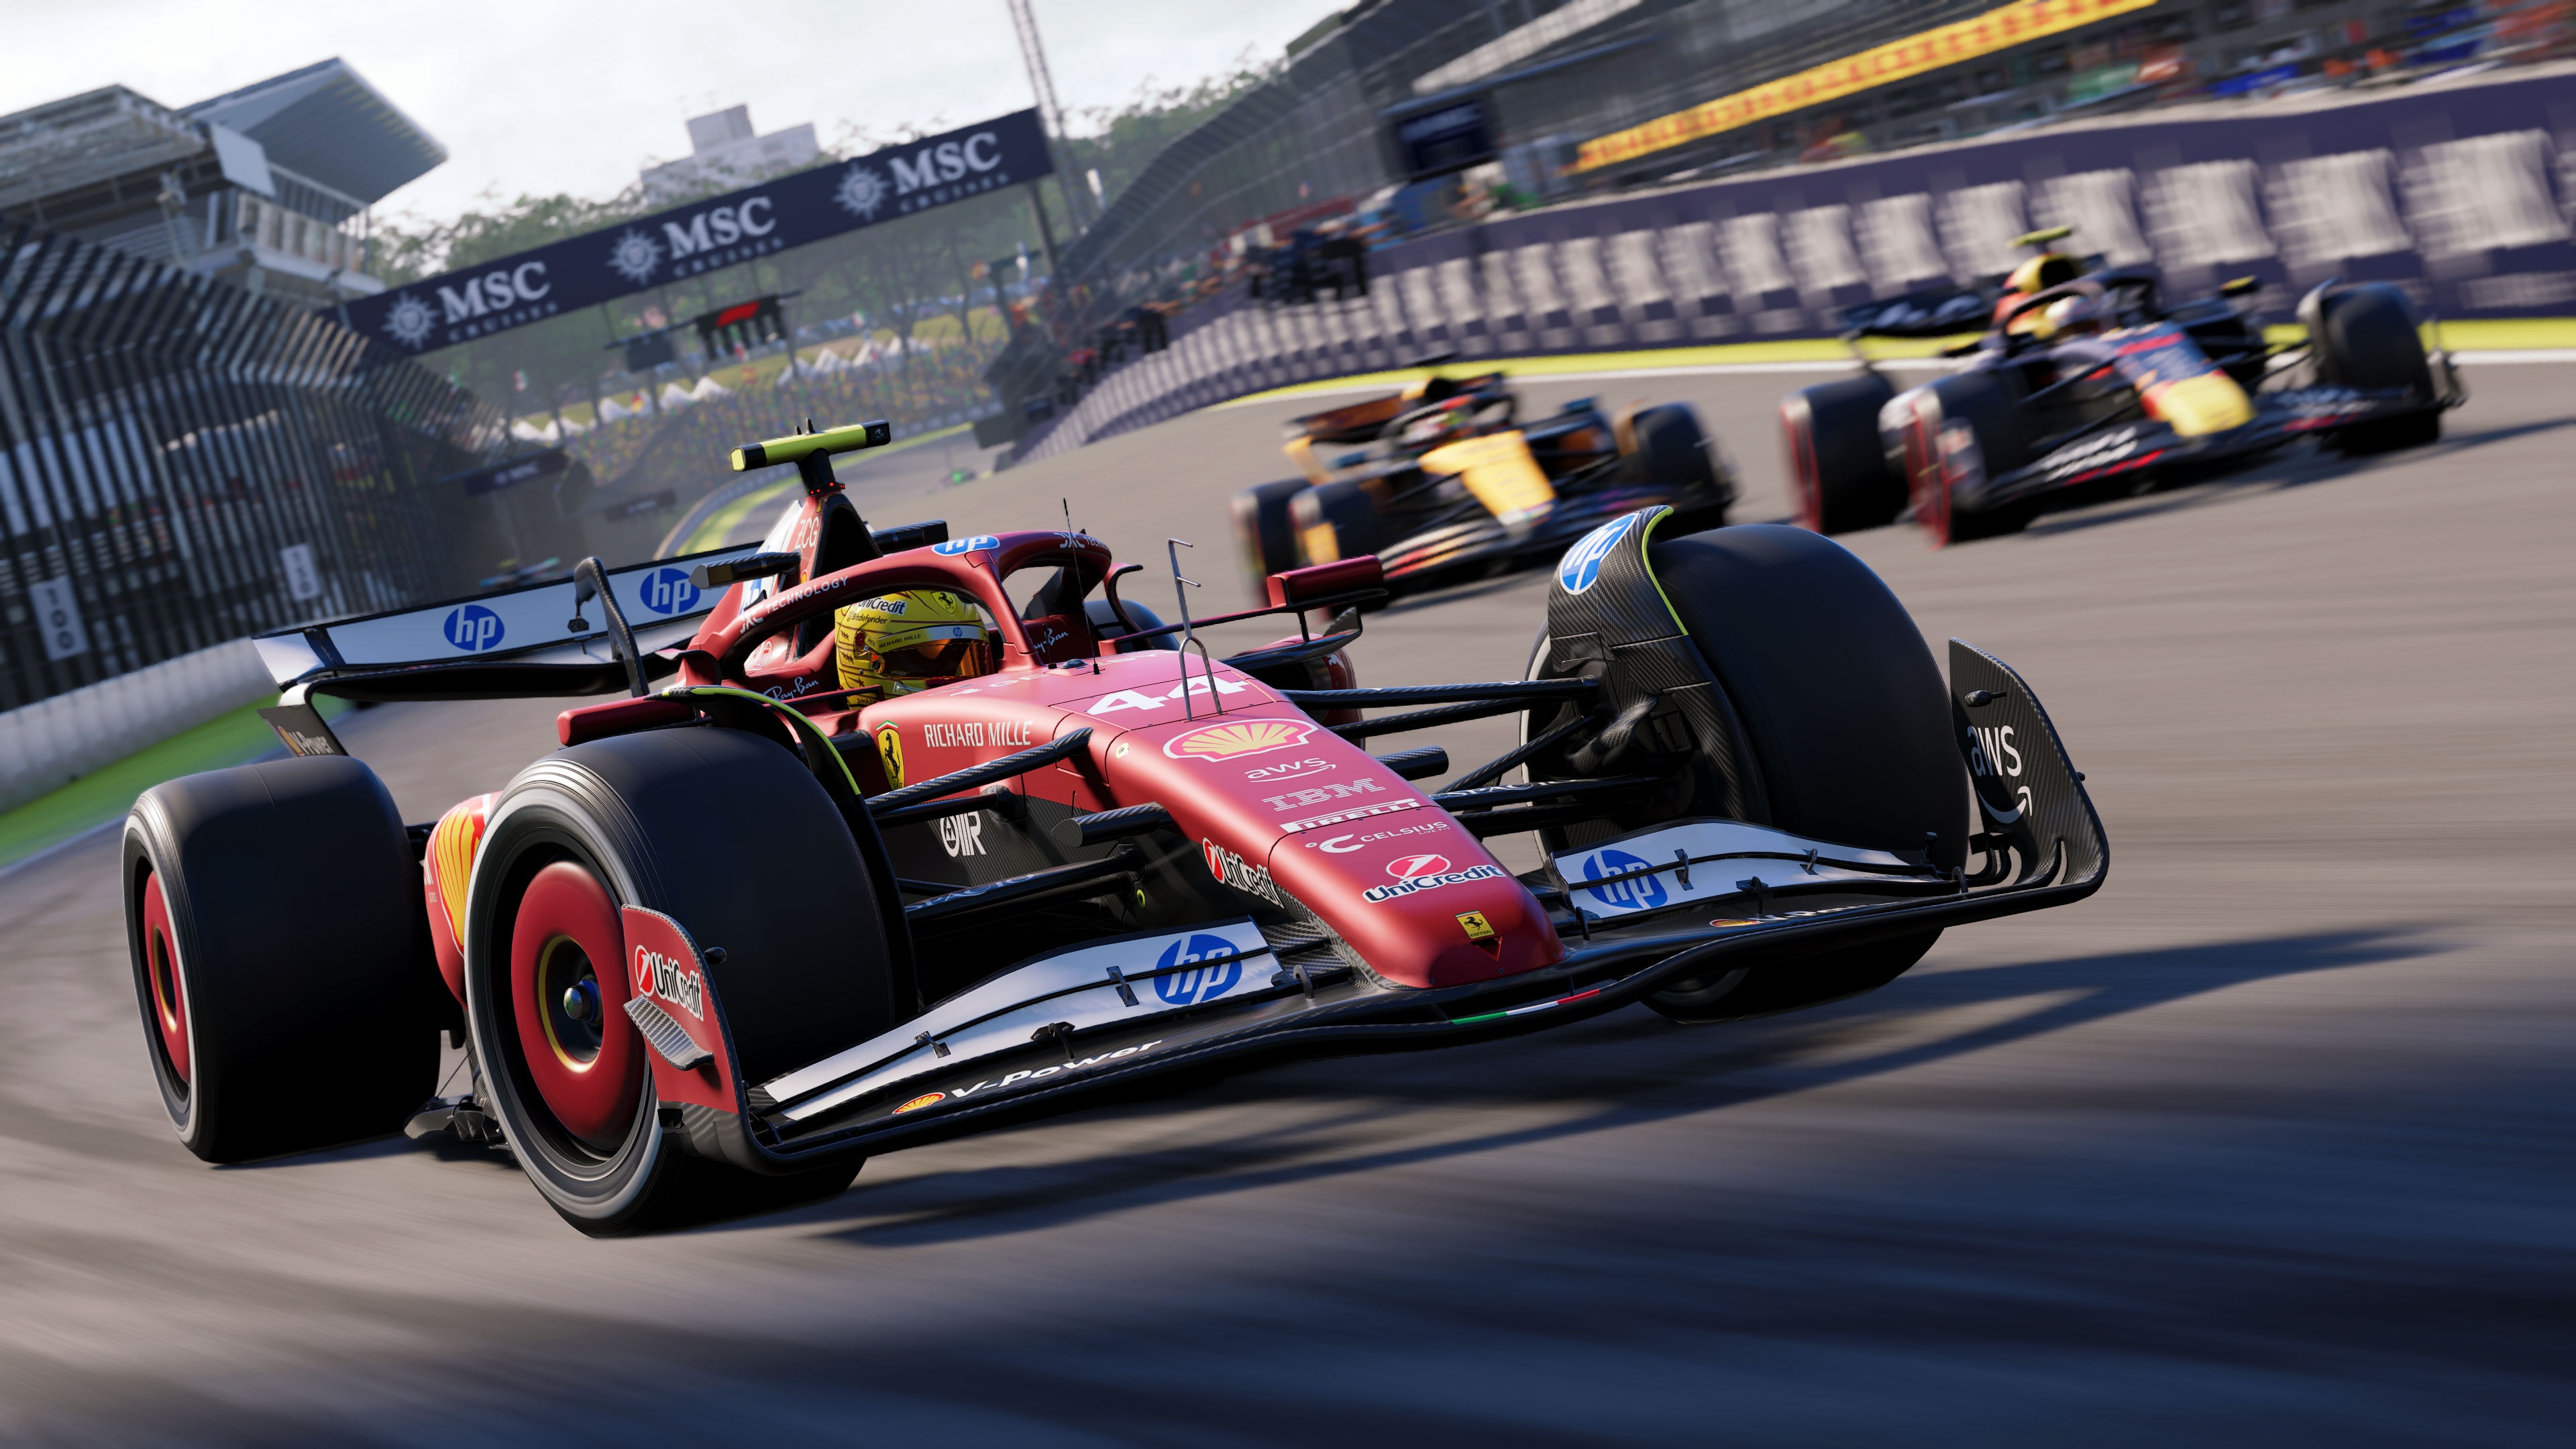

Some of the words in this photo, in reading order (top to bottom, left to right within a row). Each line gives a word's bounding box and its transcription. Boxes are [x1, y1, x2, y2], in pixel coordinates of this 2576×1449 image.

[888, 131, 1002, 195] MSC
[661, 196, 776, 260] MSC
[437, 261, 551, 324] MSC
[650, 568, 693, 614] hp
[766, 576, 848, 614] TECHNOLOGY
[454, 604, 497, 651] hp
[852, 613, 888, 625] Bitdefender
[879, 638, 902, 649] RICHARD
[904, 634, 922, 642] MILLE
[763, 676, 819, 700] Ray-Ban
[1087, 675, 1250, 715] 44
[924, 722, 984, 748] RICHARD
[988, 720, 1034, 747] MILLE
[1967, 725, 2022, 777] aws
[1244, 757, 1328, 779] aws
[1261, 778, 1386, 812] IBM
[1279, 798, 1421, 833] PIRELLI
[1360, 822, 1449, 843] CELSIUS
[1216, 845, 1283, 908] UniCredit
[1364, 864, 1505, 902] UniCredit
[1593, 851, 1654, 909] hp
[651, 953, 703, 1020] UniCredit
[1165, 934, 1234, 1005] hp
[951, 1040, 1163, 1099] V-Power
